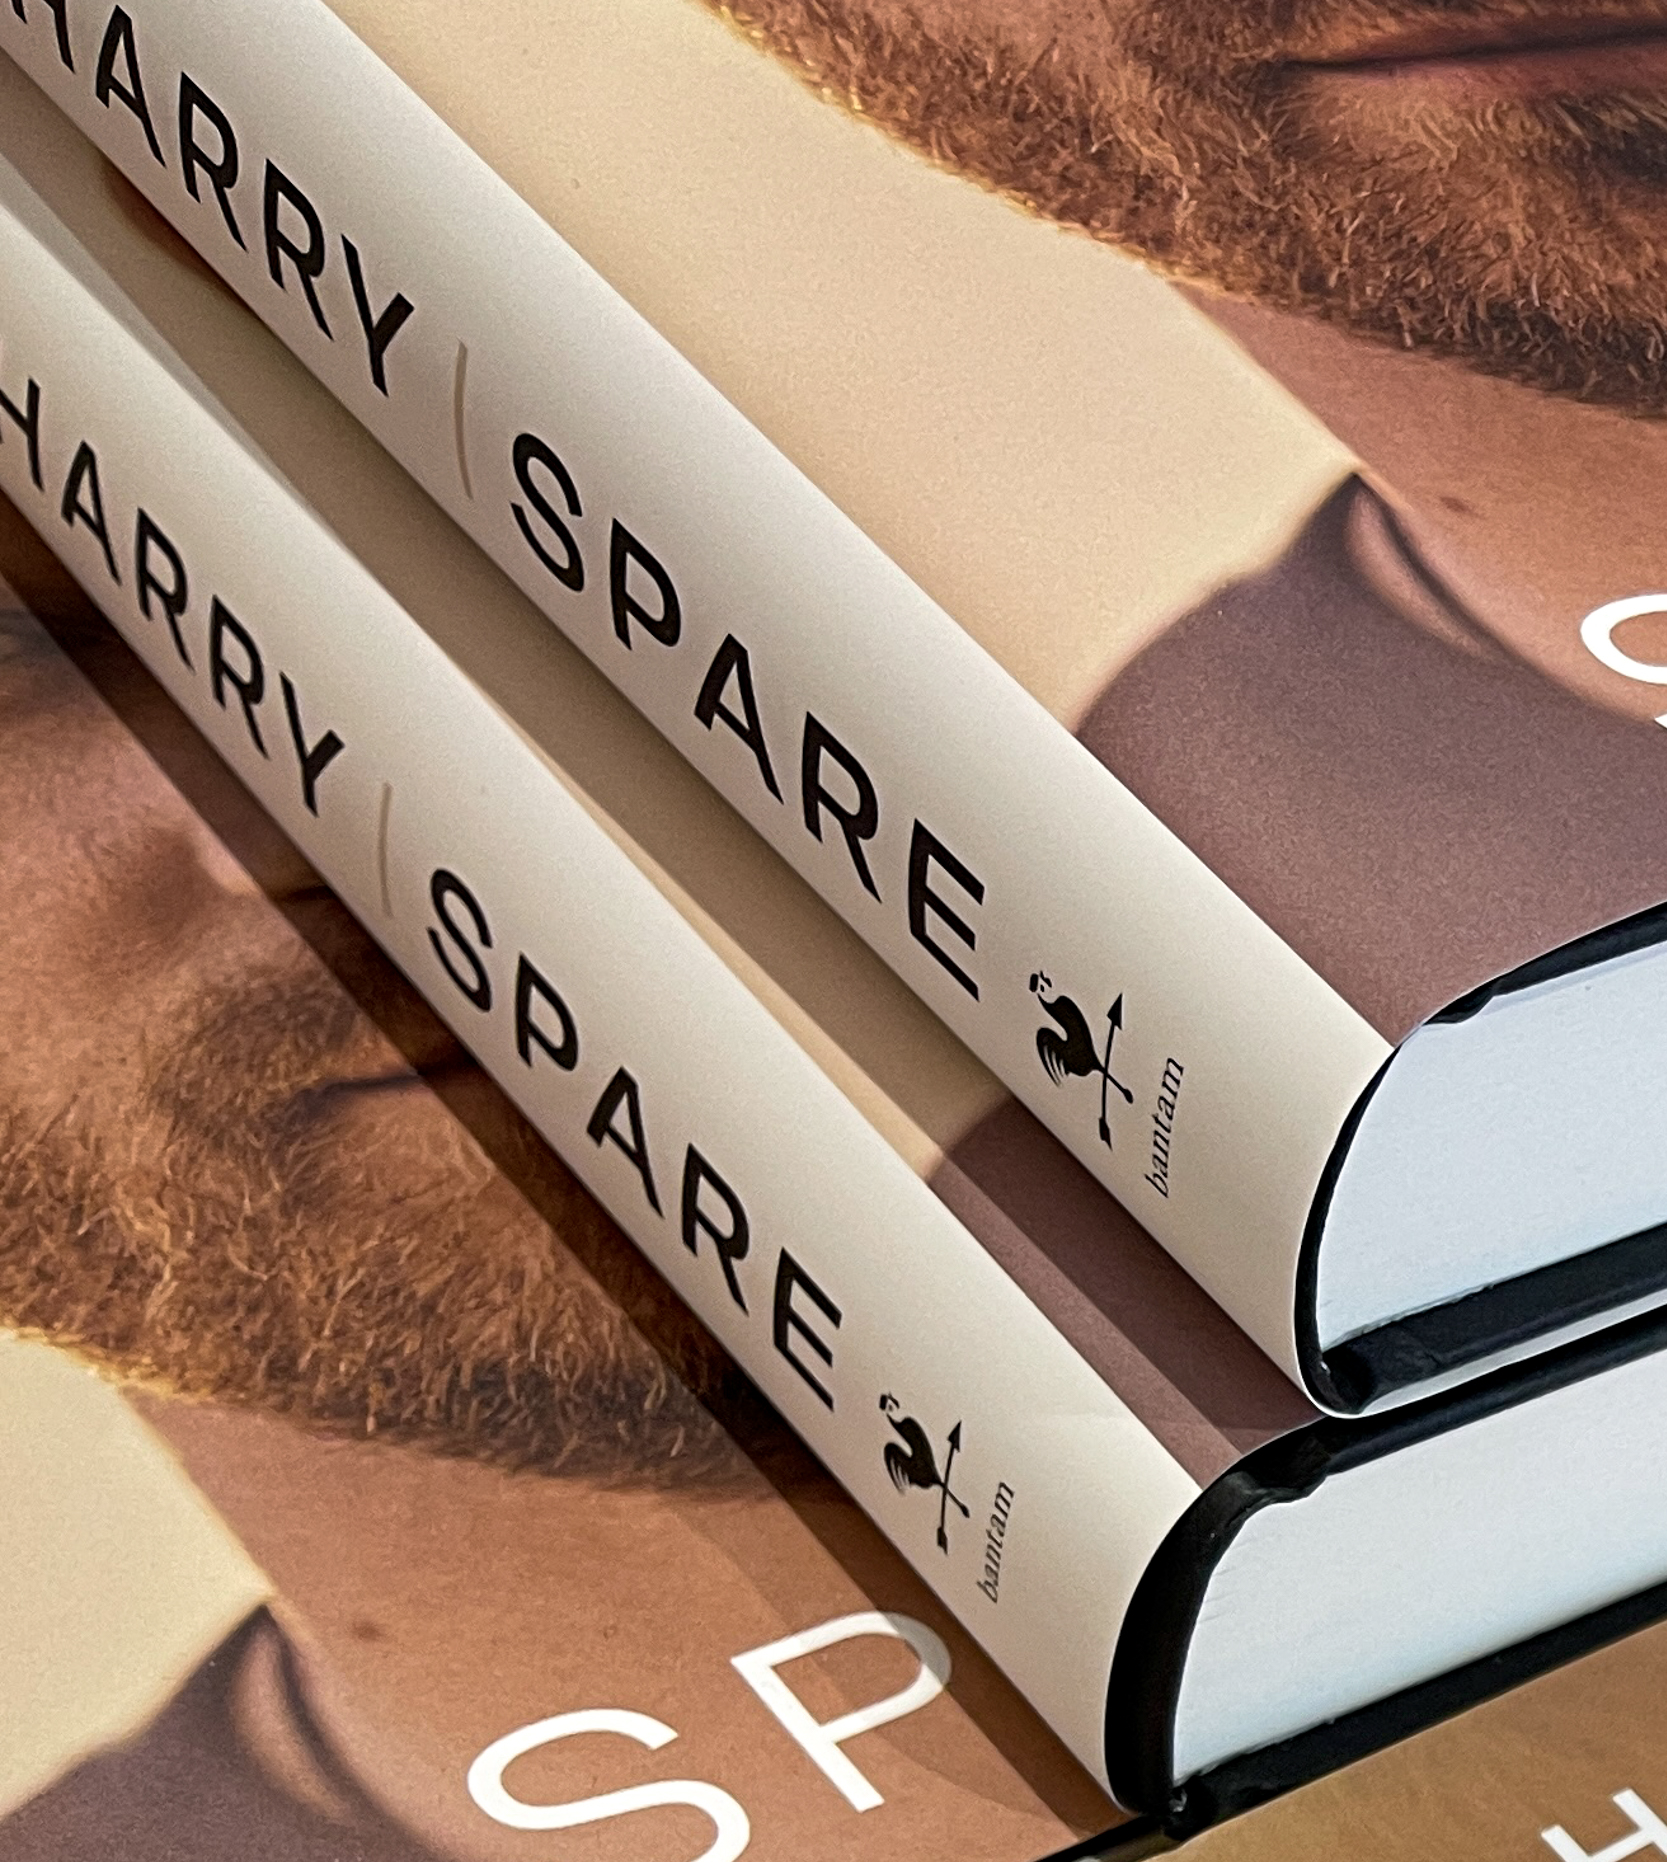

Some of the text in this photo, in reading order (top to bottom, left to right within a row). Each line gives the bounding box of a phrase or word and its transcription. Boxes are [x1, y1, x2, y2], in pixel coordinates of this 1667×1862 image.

[509, 432, 985, 1003] SPARE
[427, 868, 843, 1412] SPARE
[1143, 1057, 1185, 1199] bantam
[976, 1481, 1016, 1604] bantam
